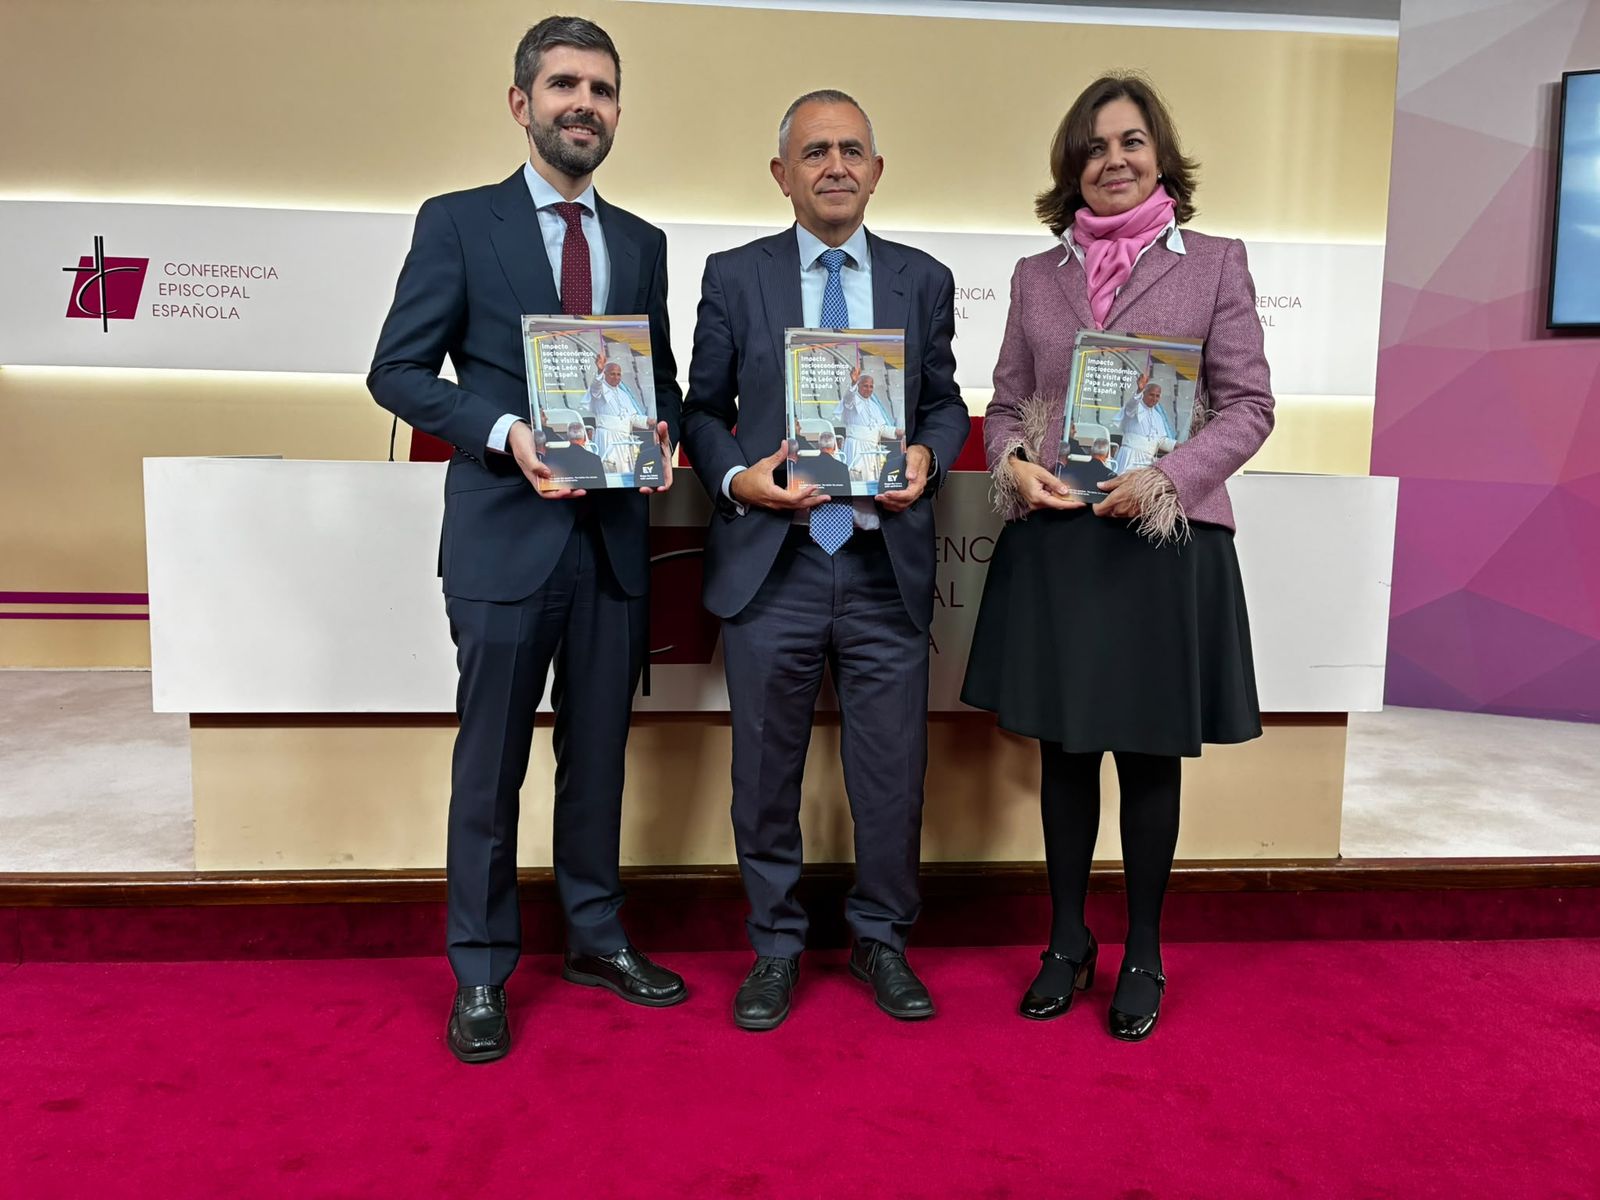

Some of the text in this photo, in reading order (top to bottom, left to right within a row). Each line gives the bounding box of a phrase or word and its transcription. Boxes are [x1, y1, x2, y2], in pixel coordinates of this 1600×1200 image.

[164, 263, 278, 280] CONFERENCIA
[159, 283, 250, 299] EPISCOPAL
[152, 302, 240, 320] ESPAÑOLA
[541, 343, 568, 351] Impacto
[1087, 358, 1114, 366] Impacto
[554, 371, 578, 379] España
[1087, 366, 1138, 375] socioeconómico
[1085, 379, 1100, 387] Papa
[1102, 380, 1118, 388] León
[1093, 386, 1116, 395] España
[642, 466, 653, 474] EY
